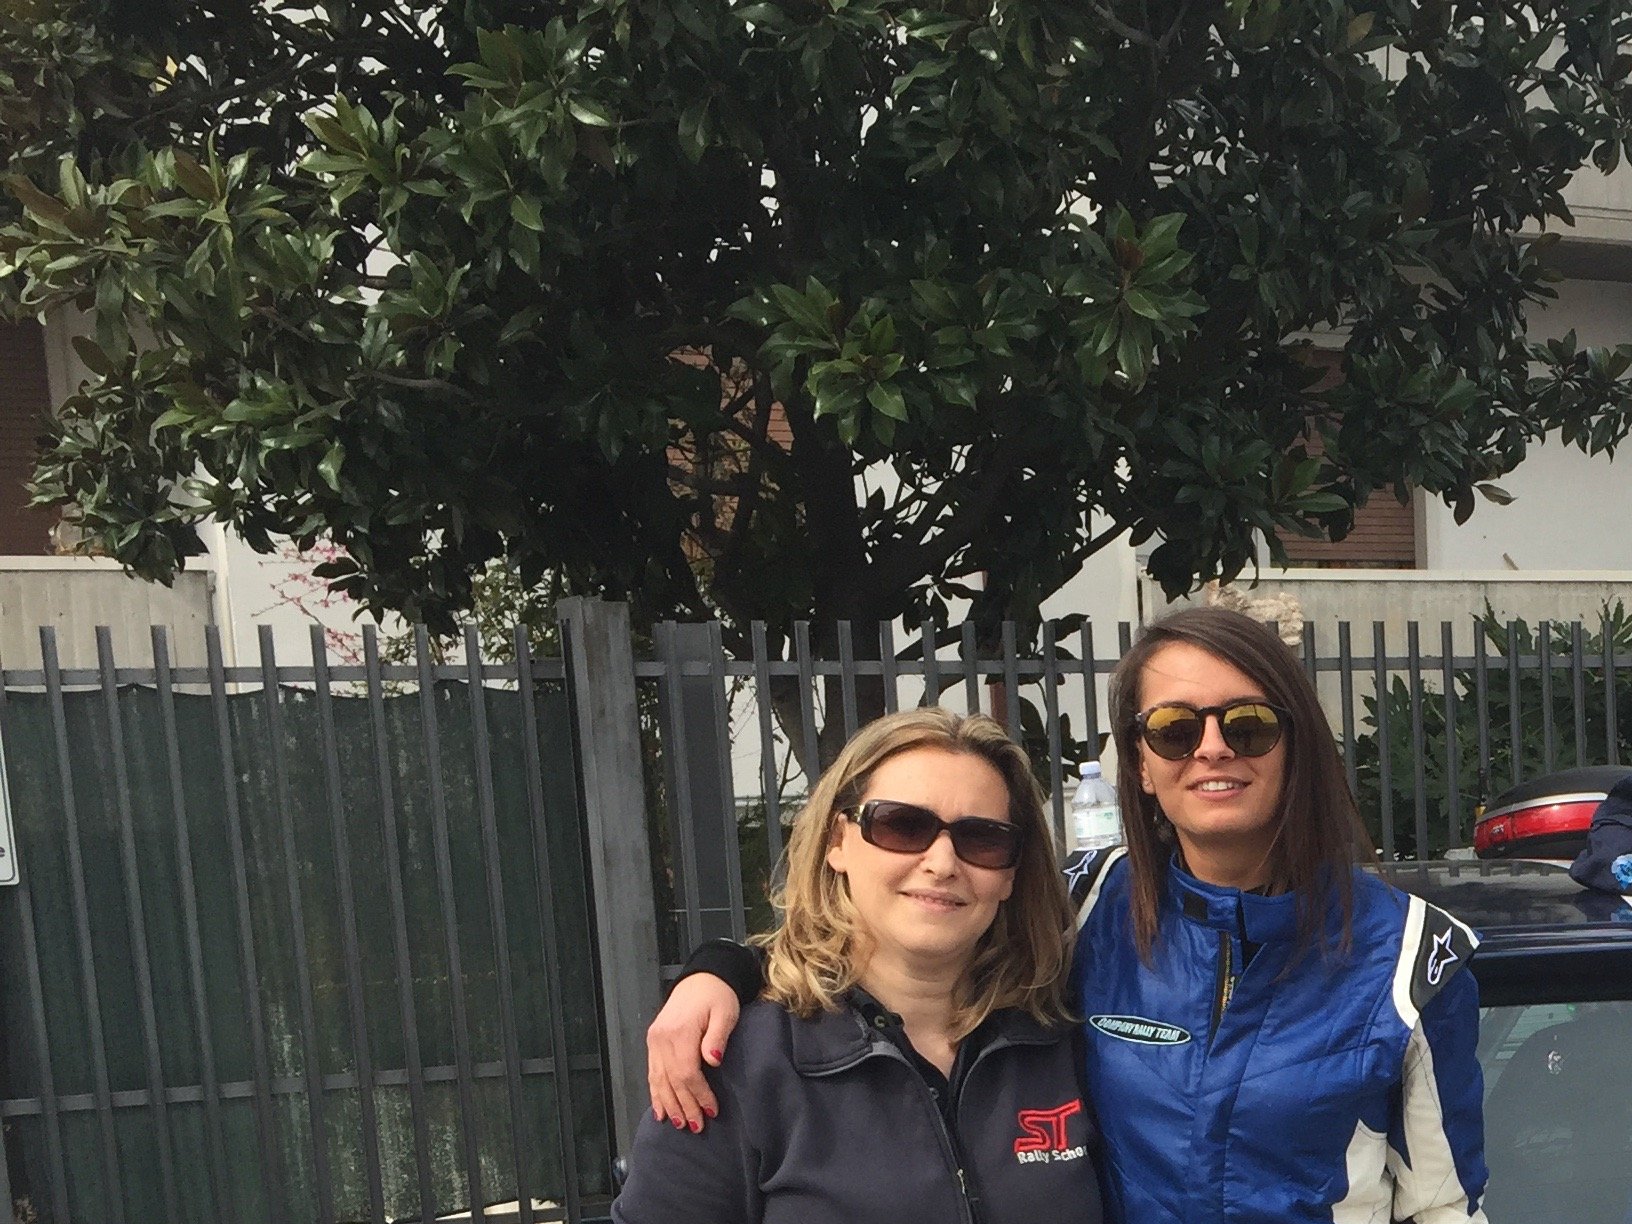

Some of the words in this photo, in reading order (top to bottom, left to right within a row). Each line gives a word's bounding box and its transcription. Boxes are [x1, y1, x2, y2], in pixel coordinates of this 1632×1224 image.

[1155, 1027, 1181, 1042] TEAM
[1013, 1098, 1082, 1153] ST
[1016, 1149, 1050, 1165] Rally
